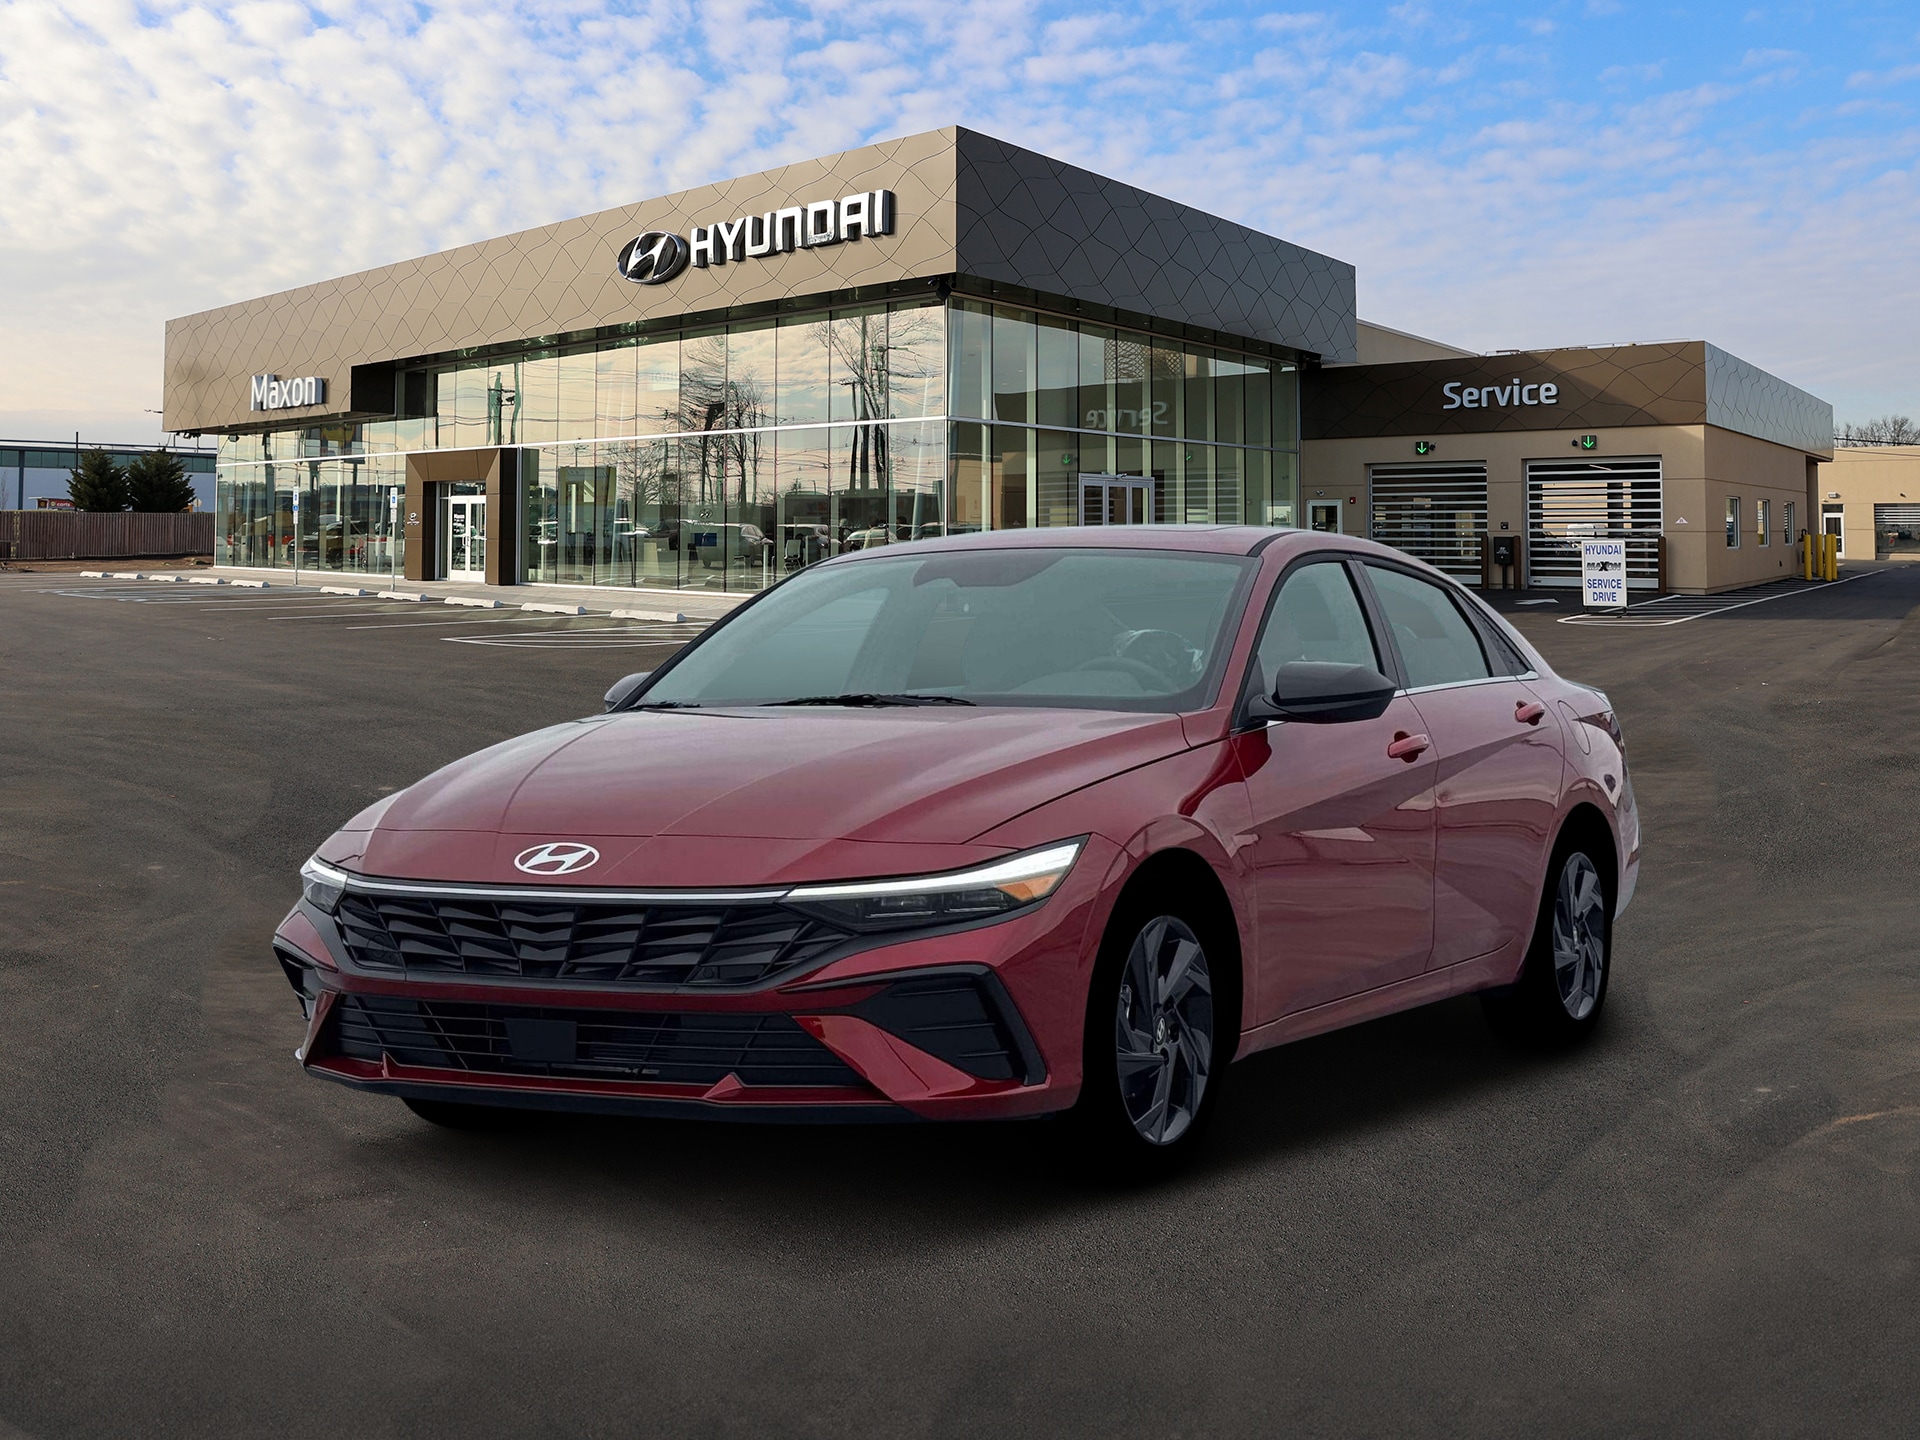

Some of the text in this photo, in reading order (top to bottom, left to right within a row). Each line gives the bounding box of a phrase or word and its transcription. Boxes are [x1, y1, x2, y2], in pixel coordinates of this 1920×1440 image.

[690, 189, 896, 267] HYUNDAI
[250, 373, 326, 412] Maxon
[1443, 378, 1558, 409] Service
[1585, 544, 1622, 555] HYUNDAI
[1586, 561, 1622, 571] MAXON
[1587, 578, 1622, 589] SERVICE
[1592, 591, 1617, 602] DRIVE
